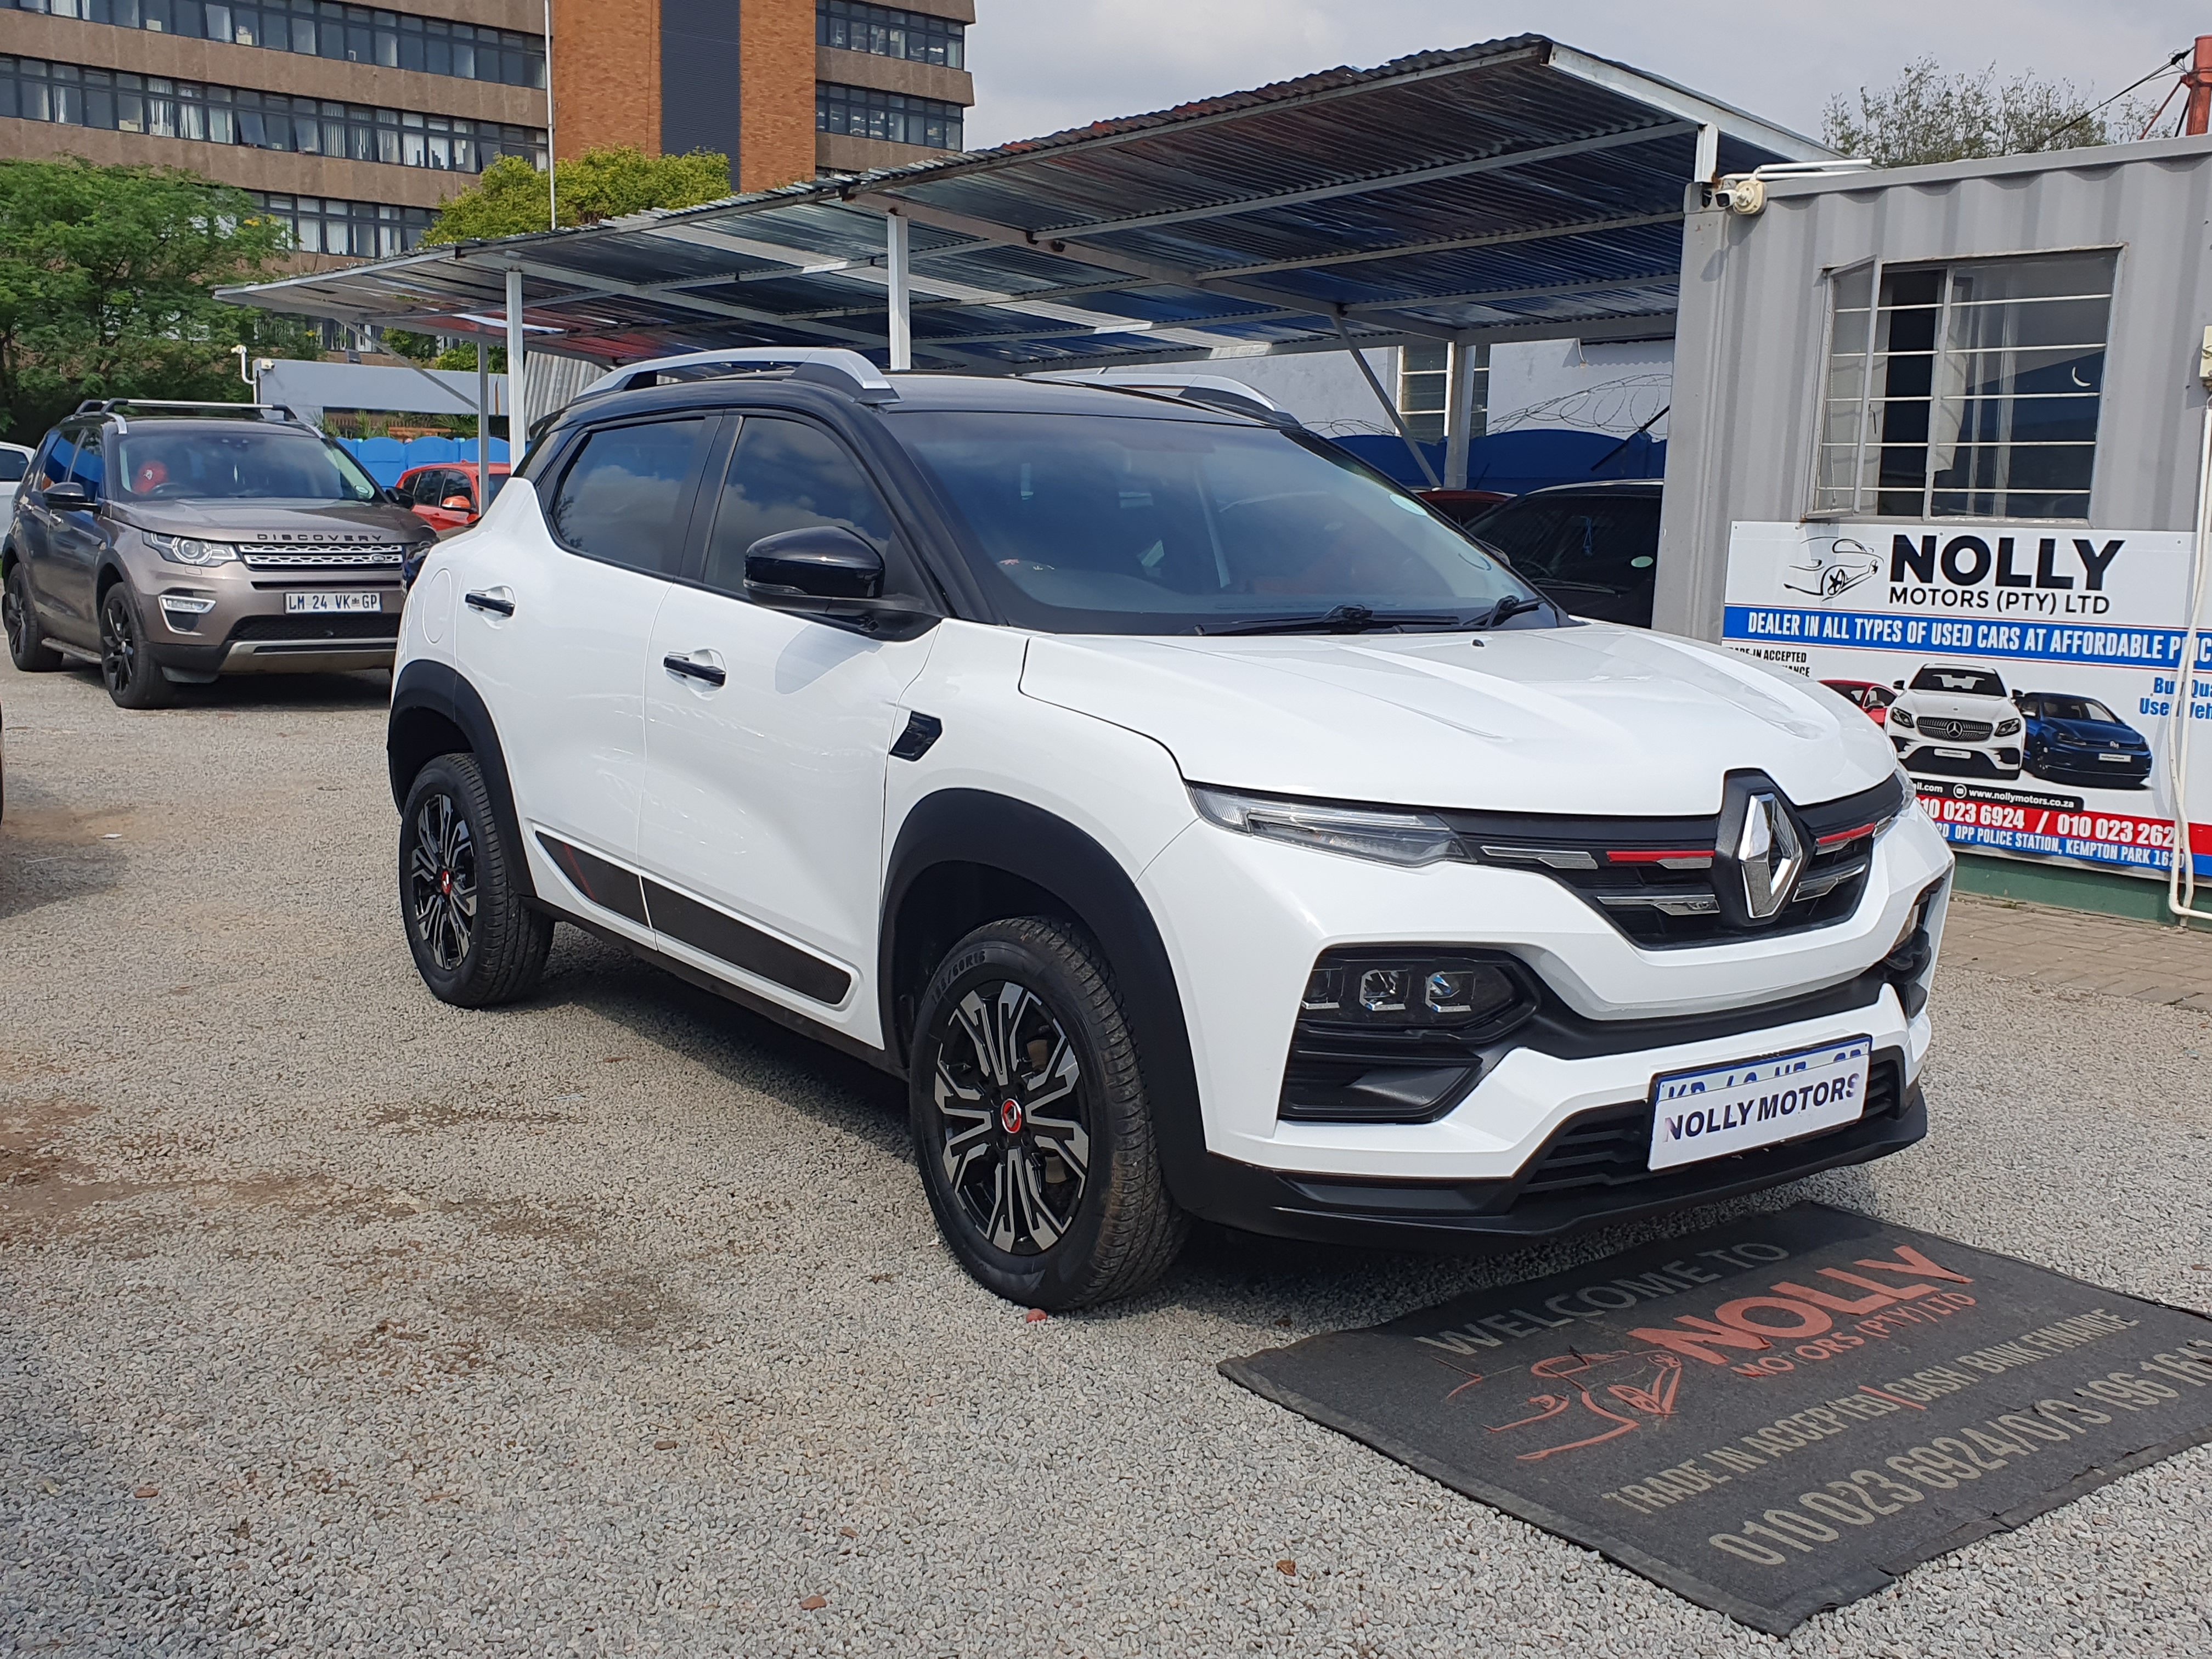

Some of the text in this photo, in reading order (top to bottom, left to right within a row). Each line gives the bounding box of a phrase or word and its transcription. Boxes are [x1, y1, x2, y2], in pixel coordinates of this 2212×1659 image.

[257, 533, 382, 542] DISCOVERY
[1889, 534, 2126, 591] NOLLY
[288, 595, 377, 610] LM 24 VK GP
[1889, 586, 2109, 615] MOTORS (PTY) LTD
[1748, 611, 1800, 636] DEALER
[1804, 615, 1820, 637] IN
[1822, 617, 1849, 639] ALL
[1854, 618, 1902, 642] TYPES
[1907, 620, 1927, 644] OF
[1931, 622, 1973, 647] USED
[1977, 625, 2020, 650] CARS
[2024, 628, 2047, 652] AT
[2050, 629, 2164, 659] AFFORDABLE
[1763, 649, 1807, 663] ACCEPTED
[2140, 697, 2181, 717] Use
[2153, 677, 2212, 698] Bu Qu
[1968, 788, 2074, 808] www.nollymotors.co.za
[1943, 800, 1977, 823] 023
[1979, 805, 2025, 830] 6924
[2035, 811, 2050, 834] /
[2057, 814, 2092, 838] 010
[2096, 818, 2133, 843] 023
[1955, 824, 1974, 841] OPP
[1977, 828, 2012, 847] POLICE
[2015, 832, 2062, 855] STATION,
[2066, 839, 2118, 861] KEMPTON
[2120, 846, 2151, 865] PARK
[1663, 1099, 1755, 1143] NOLLY
[1757, 1073, 1860, 1122] MOTORS
[1414, 1243, 1790, 1355] WELCOME TO
[1627, 1245, 1974, 1365] NOLLY
[1730, 1293, 1976, 1378] MOTORS (PTY) LTD
[1601, 1458, 1733, 1514] TRADE
[1702, 1446, 1768, 1473] IN
[1740, 1393, 1901, 1458] ACCEPTED
[1883, 1365, 1980, 1402] CASH
[1955, 1340, 2052, 1374] BANK
[2020, 1308, 2140, 1349] FINANCE
[1708, 1509, 1839, 1566] 010
[1799, 1469, 1925, 1526] 023
[1885, 1399, 2112, 1489] 6924/073
[2073, 1372, 2180, 1412] 196
